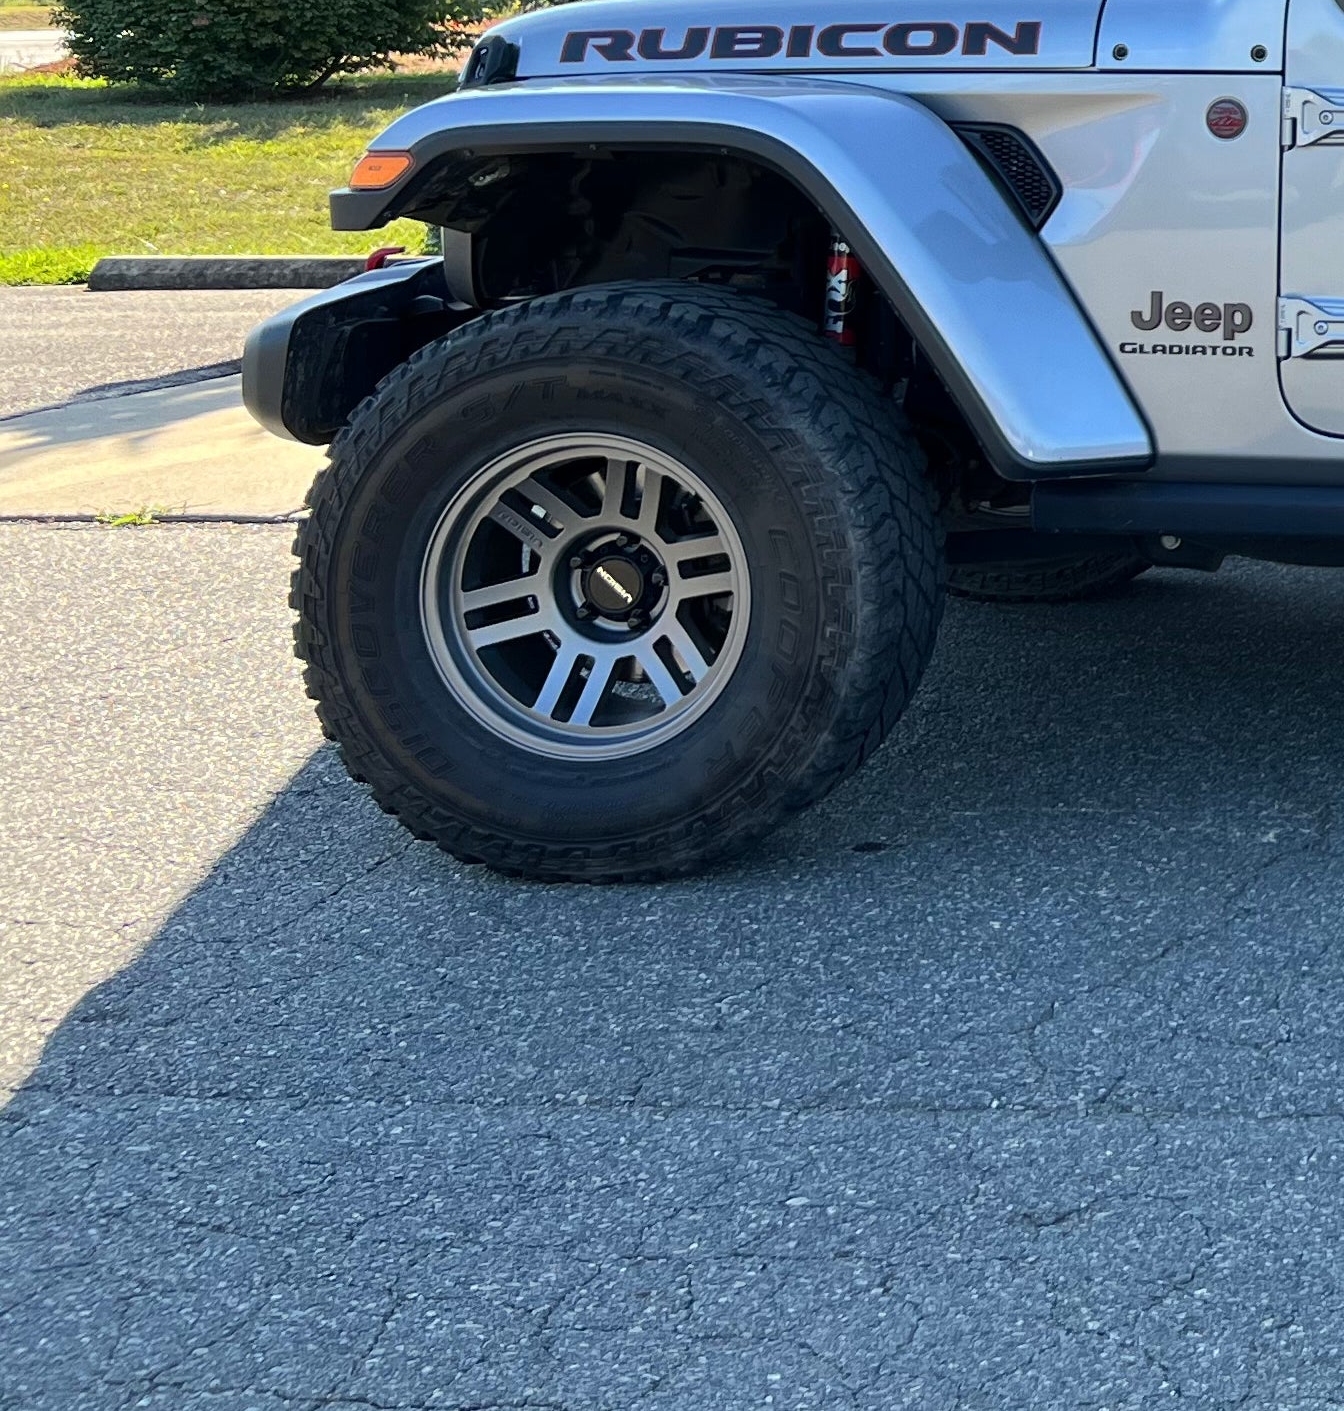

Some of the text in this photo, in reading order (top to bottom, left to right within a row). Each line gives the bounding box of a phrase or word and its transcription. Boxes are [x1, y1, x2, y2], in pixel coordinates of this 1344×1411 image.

[559, 20, 1042, 63] RUBICON
[1130, 290, 1253, 340] Jeep
[1119, 342, 1255, 357] GLADIATOR
[704, 528, 803, 779] COOPER
